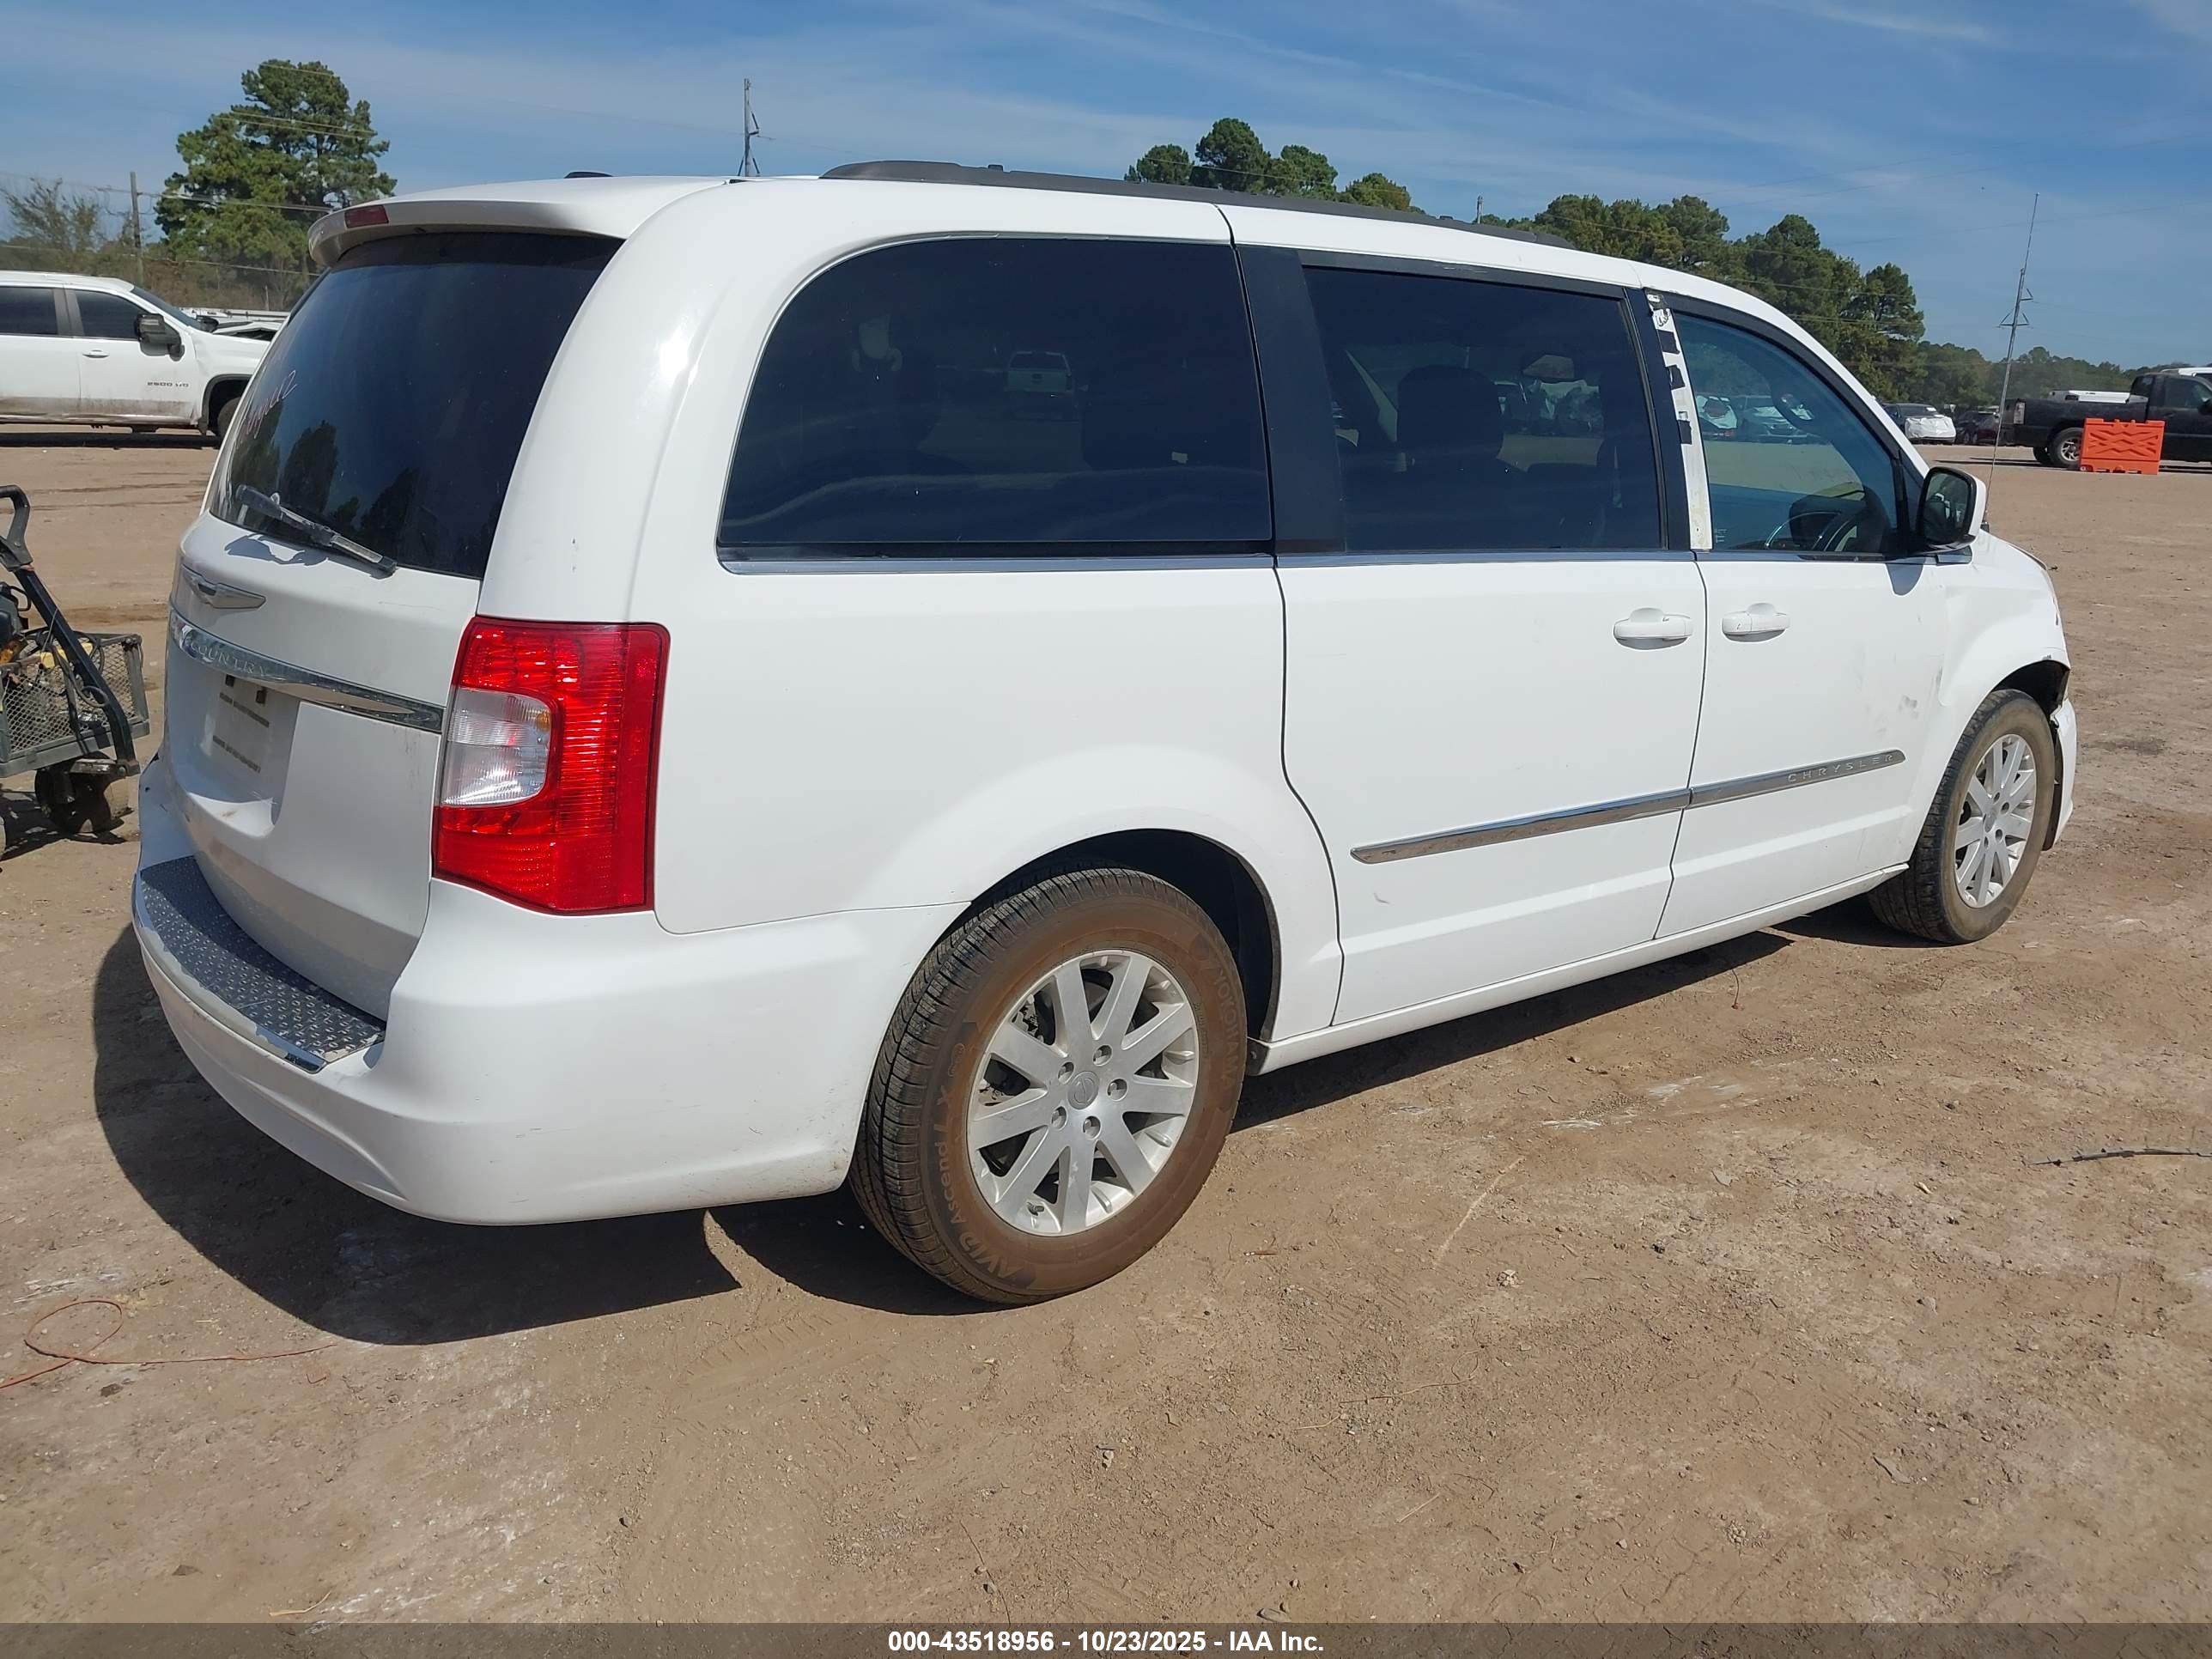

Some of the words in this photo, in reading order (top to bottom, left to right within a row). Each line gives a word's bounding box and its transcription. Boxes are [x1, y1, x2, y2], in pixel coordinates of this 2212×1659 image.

[190, 642, 269, 677] COUNTRY
[1787, 754, 1893, 782] CHRYSLER
[1214, 967, 1238, 1089] YOKOHAMA
[935, 1142, 967, 1224] Ascend
[959, 1231, 1018, 1279] AVID
